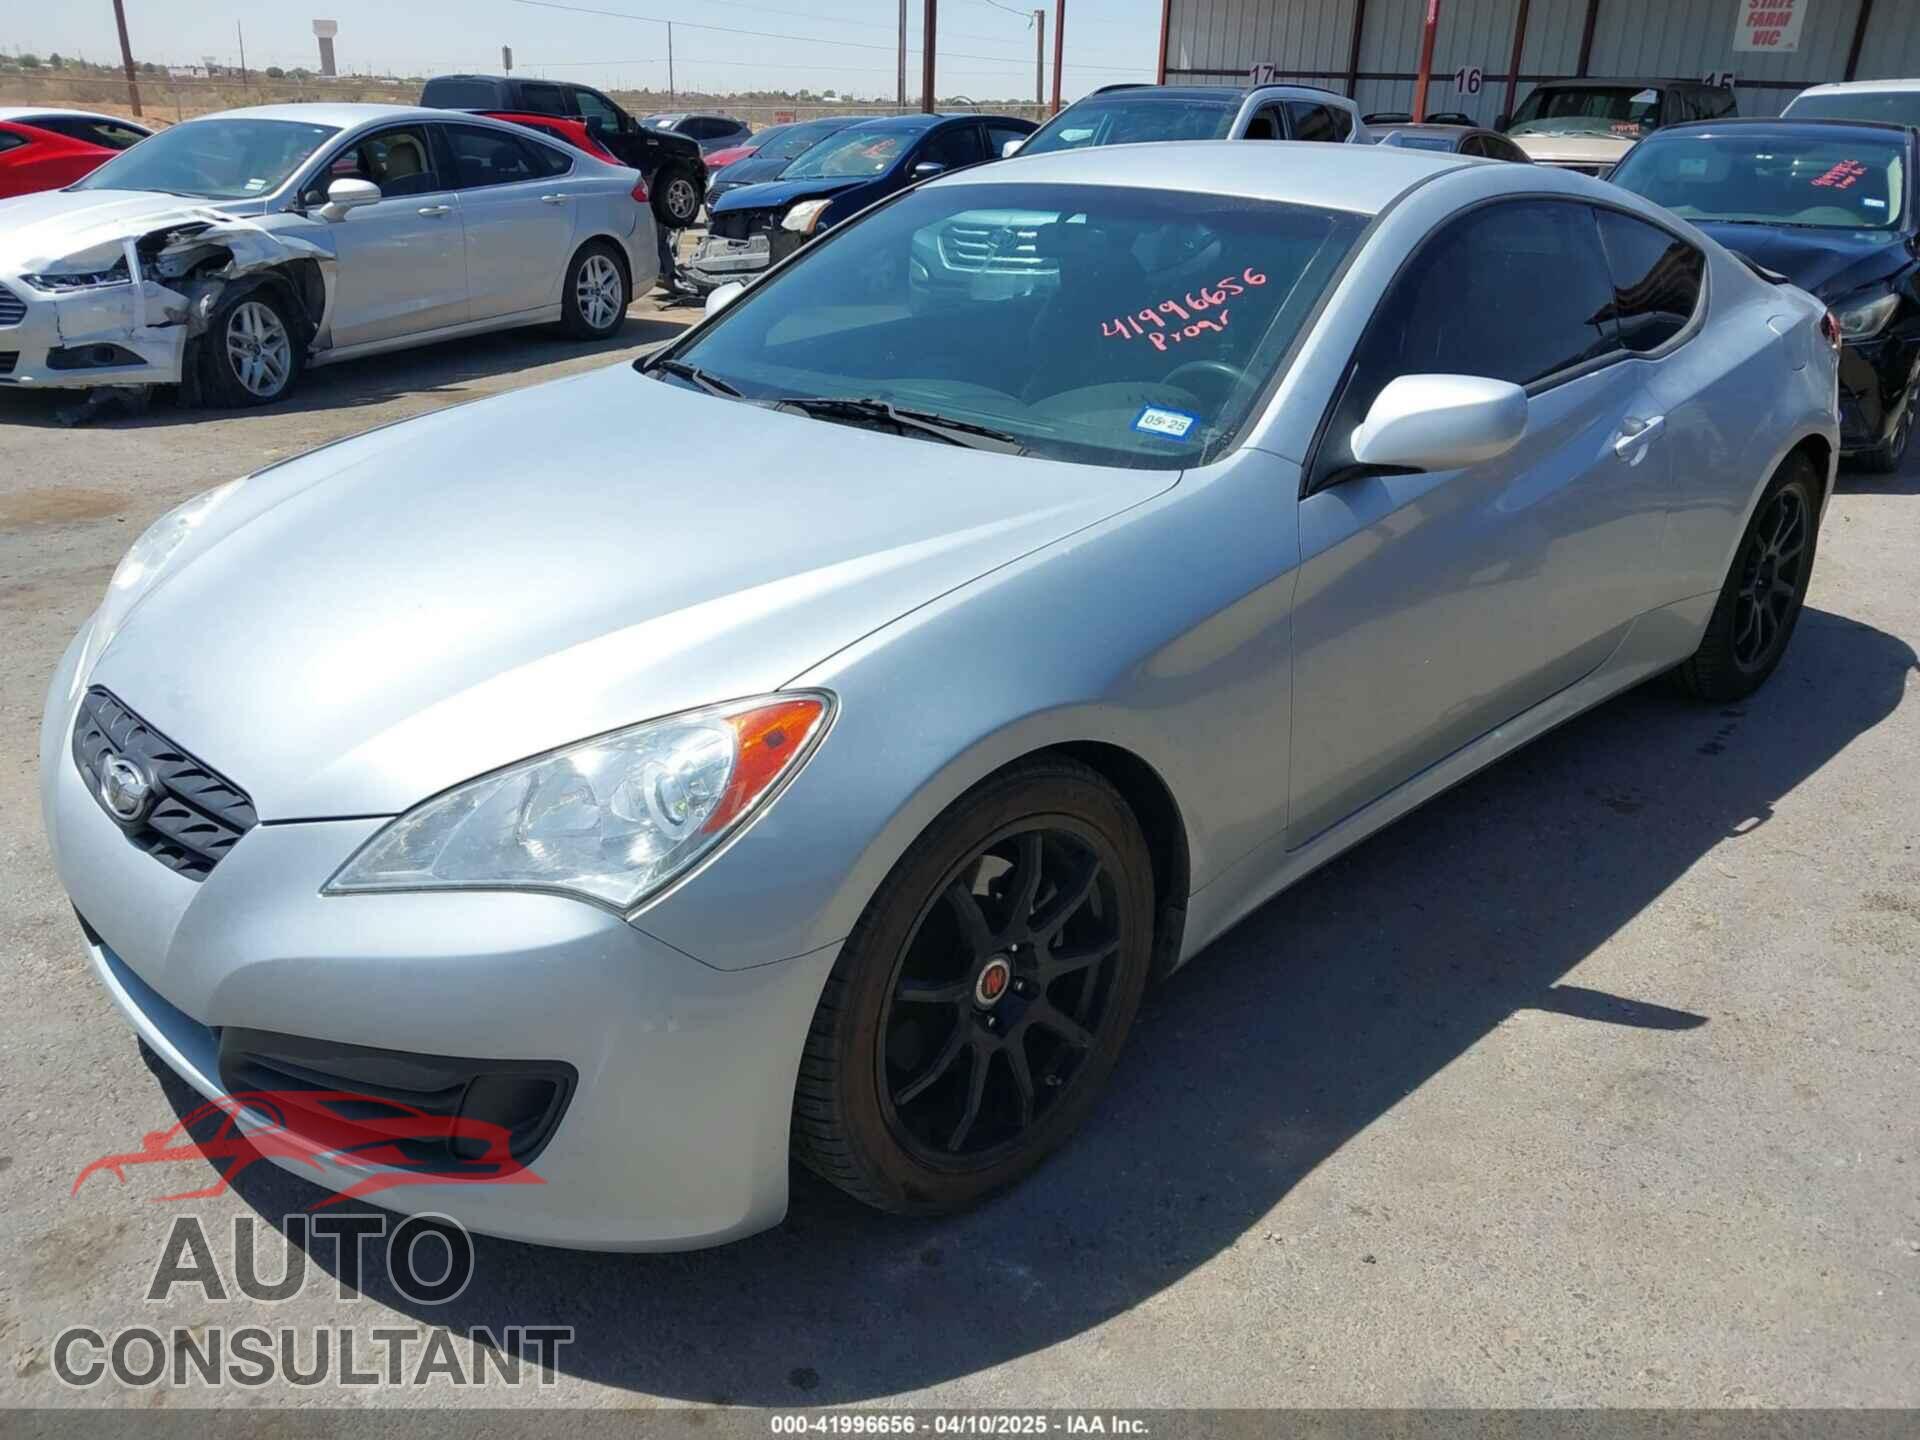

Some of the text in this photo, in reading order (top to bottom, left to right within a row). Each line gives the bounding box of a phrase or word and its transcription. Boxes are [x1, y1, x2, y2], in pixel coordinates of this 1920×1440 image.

[1745, 11, 1792, 28] FARM
[1752, 30, 1781, 47] VIC
[1251, 64, 1274, 85] 17
[1456, 67, 1481, 94] 16
[1101, 267, 1267, 339] 41996656
